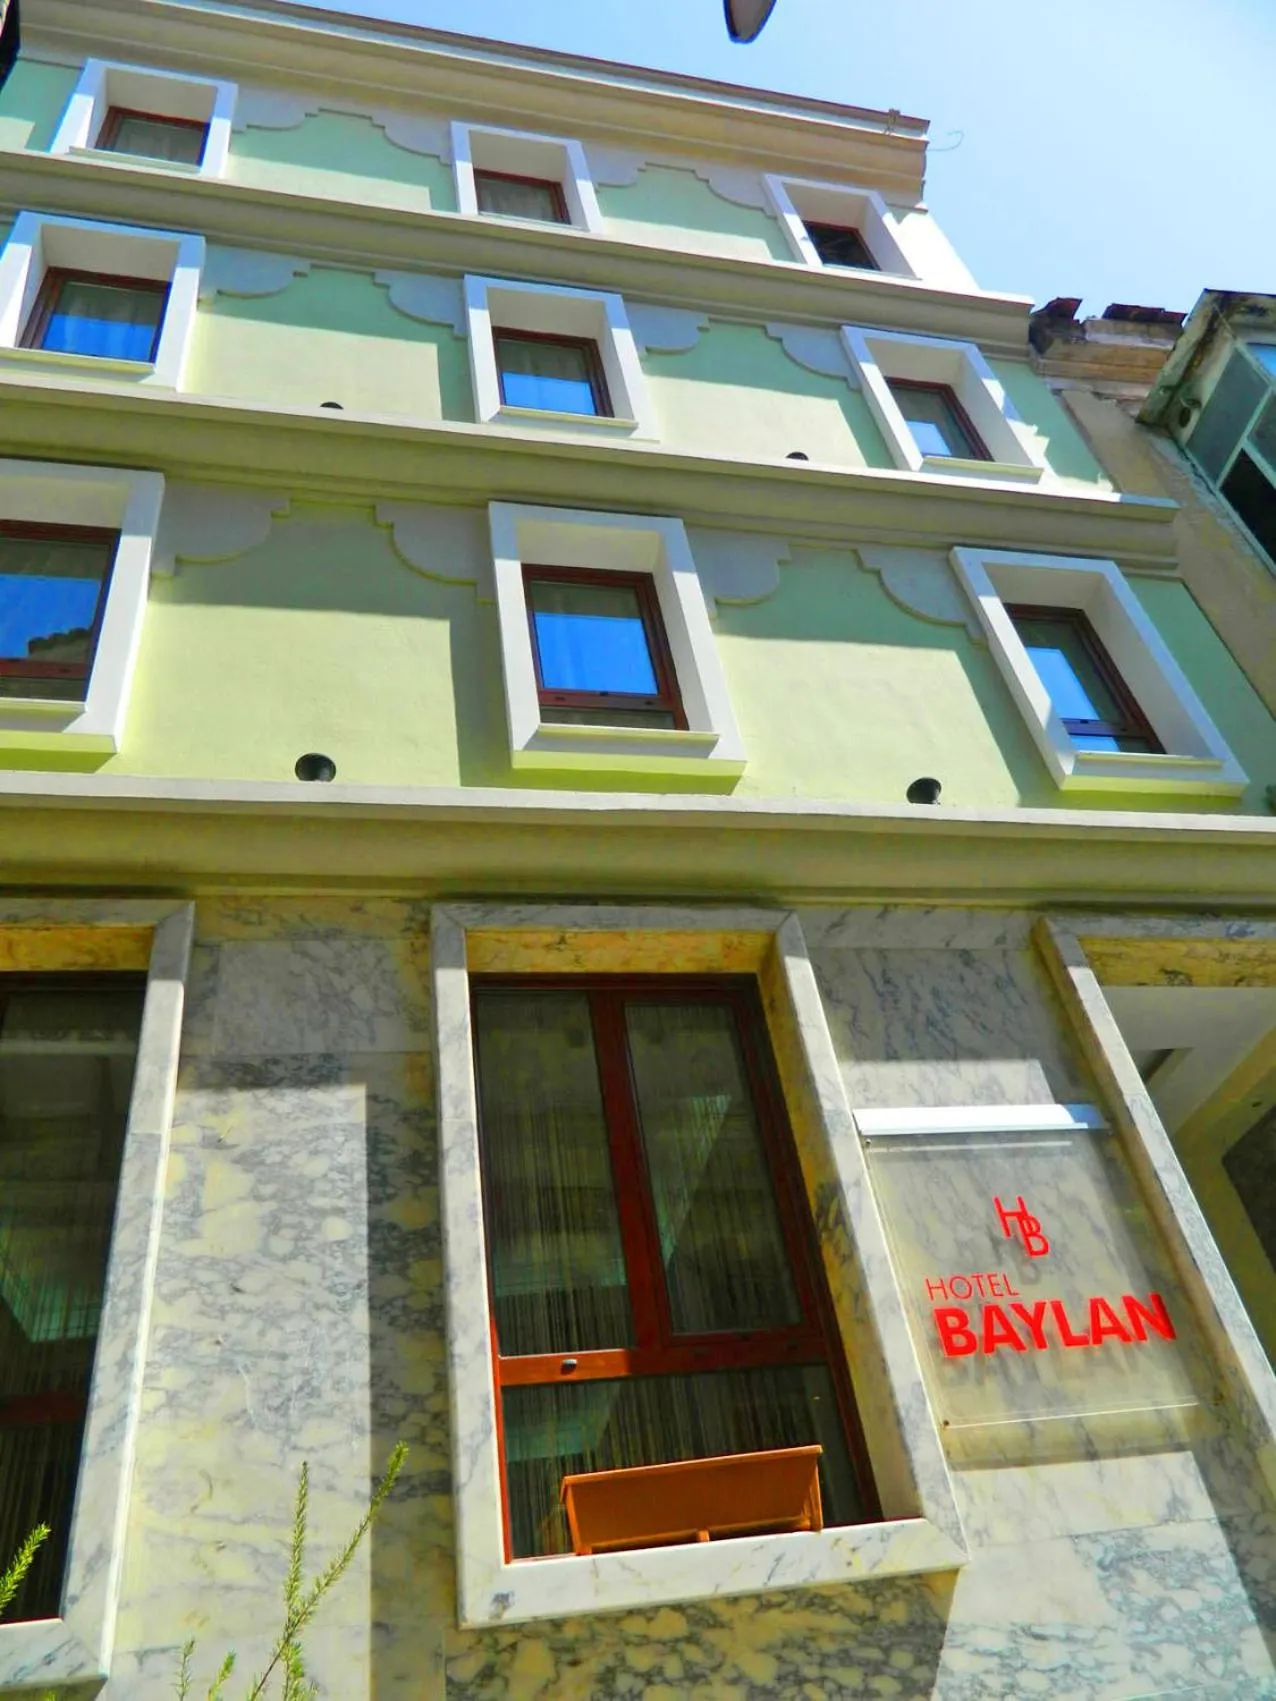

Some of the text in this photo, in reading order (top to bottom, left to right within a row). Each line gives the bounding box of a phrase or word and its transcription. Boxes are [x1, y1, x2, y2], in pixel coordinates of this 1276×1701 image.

[993, 1196, 1050, 1258] HB
[925, 1272, 1019, 1301] HOTEL
[932, 1291, 1177, 1359] BAYLAN
